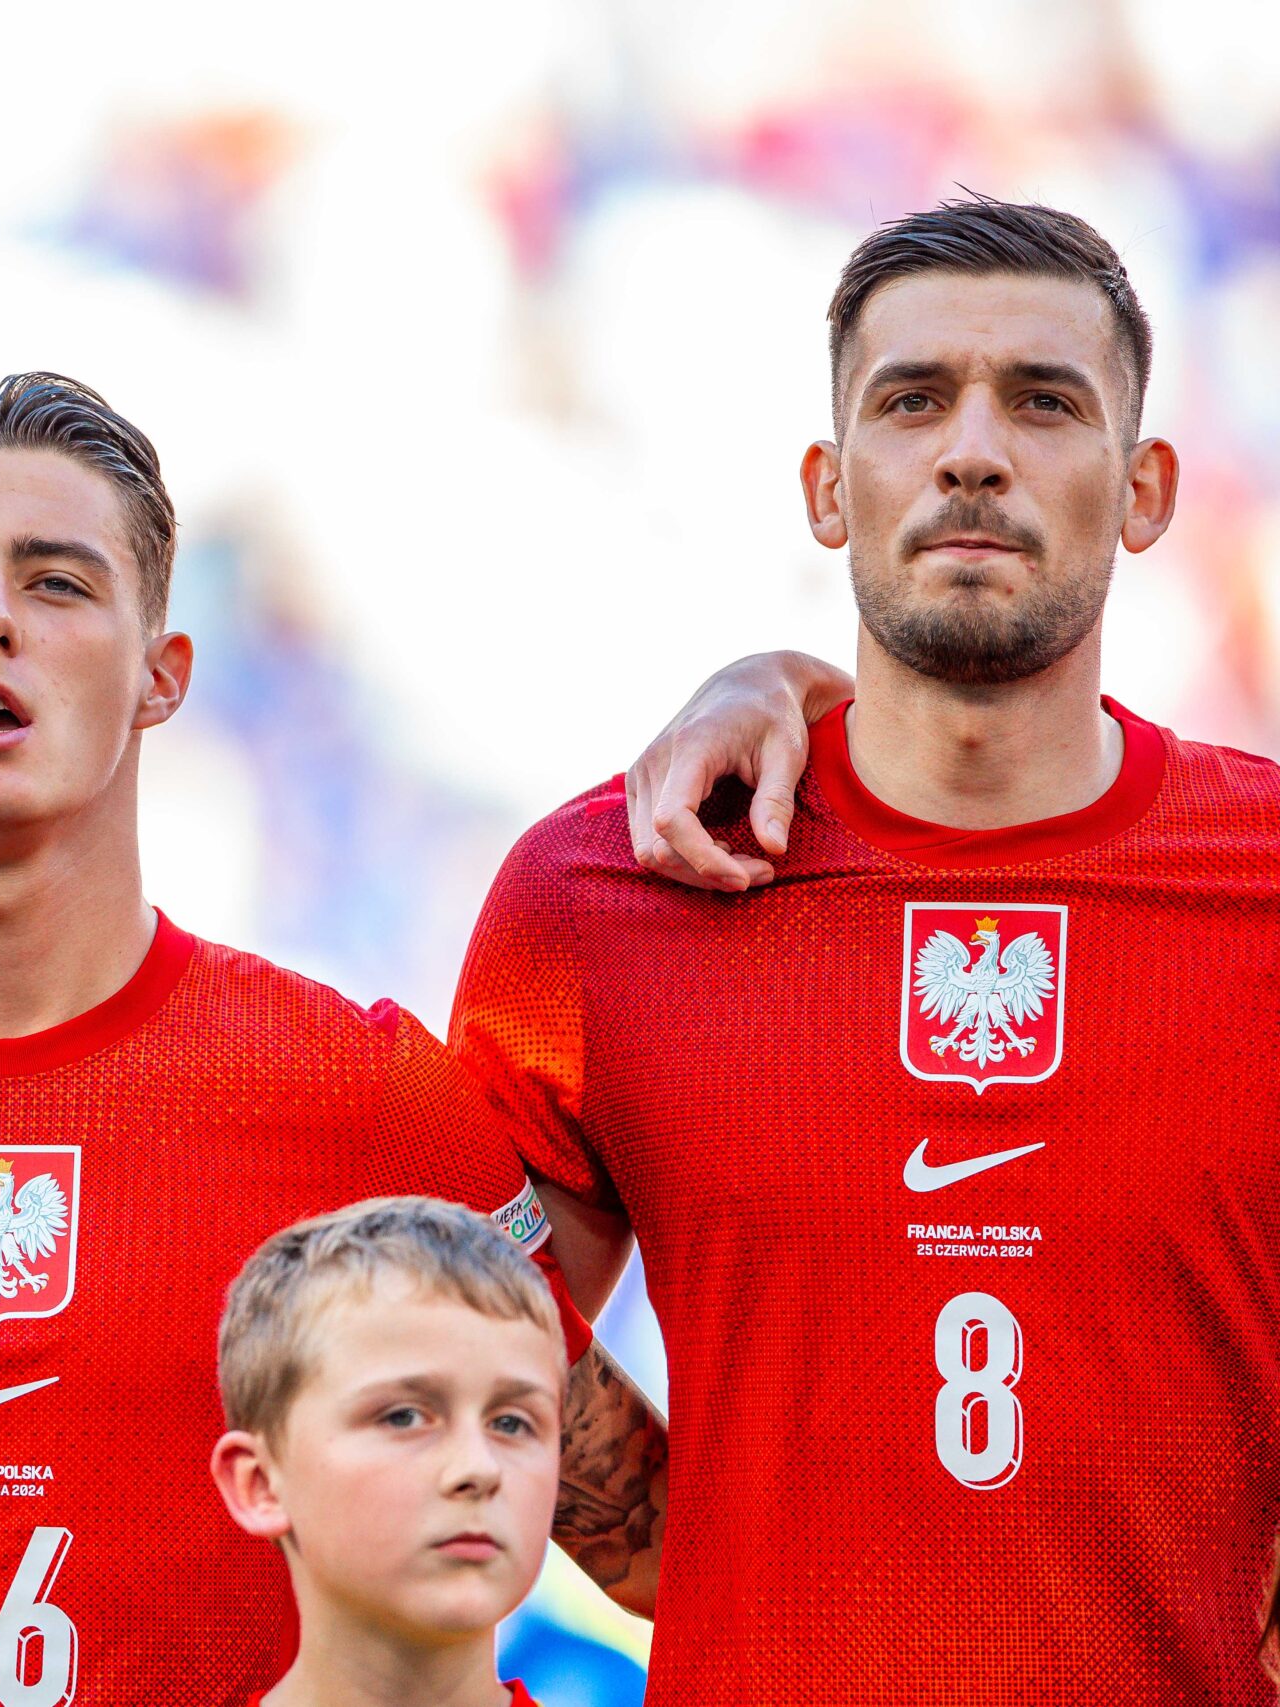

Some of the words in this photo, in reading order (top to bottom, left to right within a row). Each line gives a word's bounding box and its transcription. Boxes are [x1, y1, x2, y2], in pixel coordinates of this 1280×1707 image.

[916, 1244, 933, 1256] 25
[935, 1244, 998, 1257] CZERWCA
[1000, 1245, 1033, 1258] 2024
[934, 1291, 1023, 1491] 8
[11, 1484, 45, 1497] 2024
